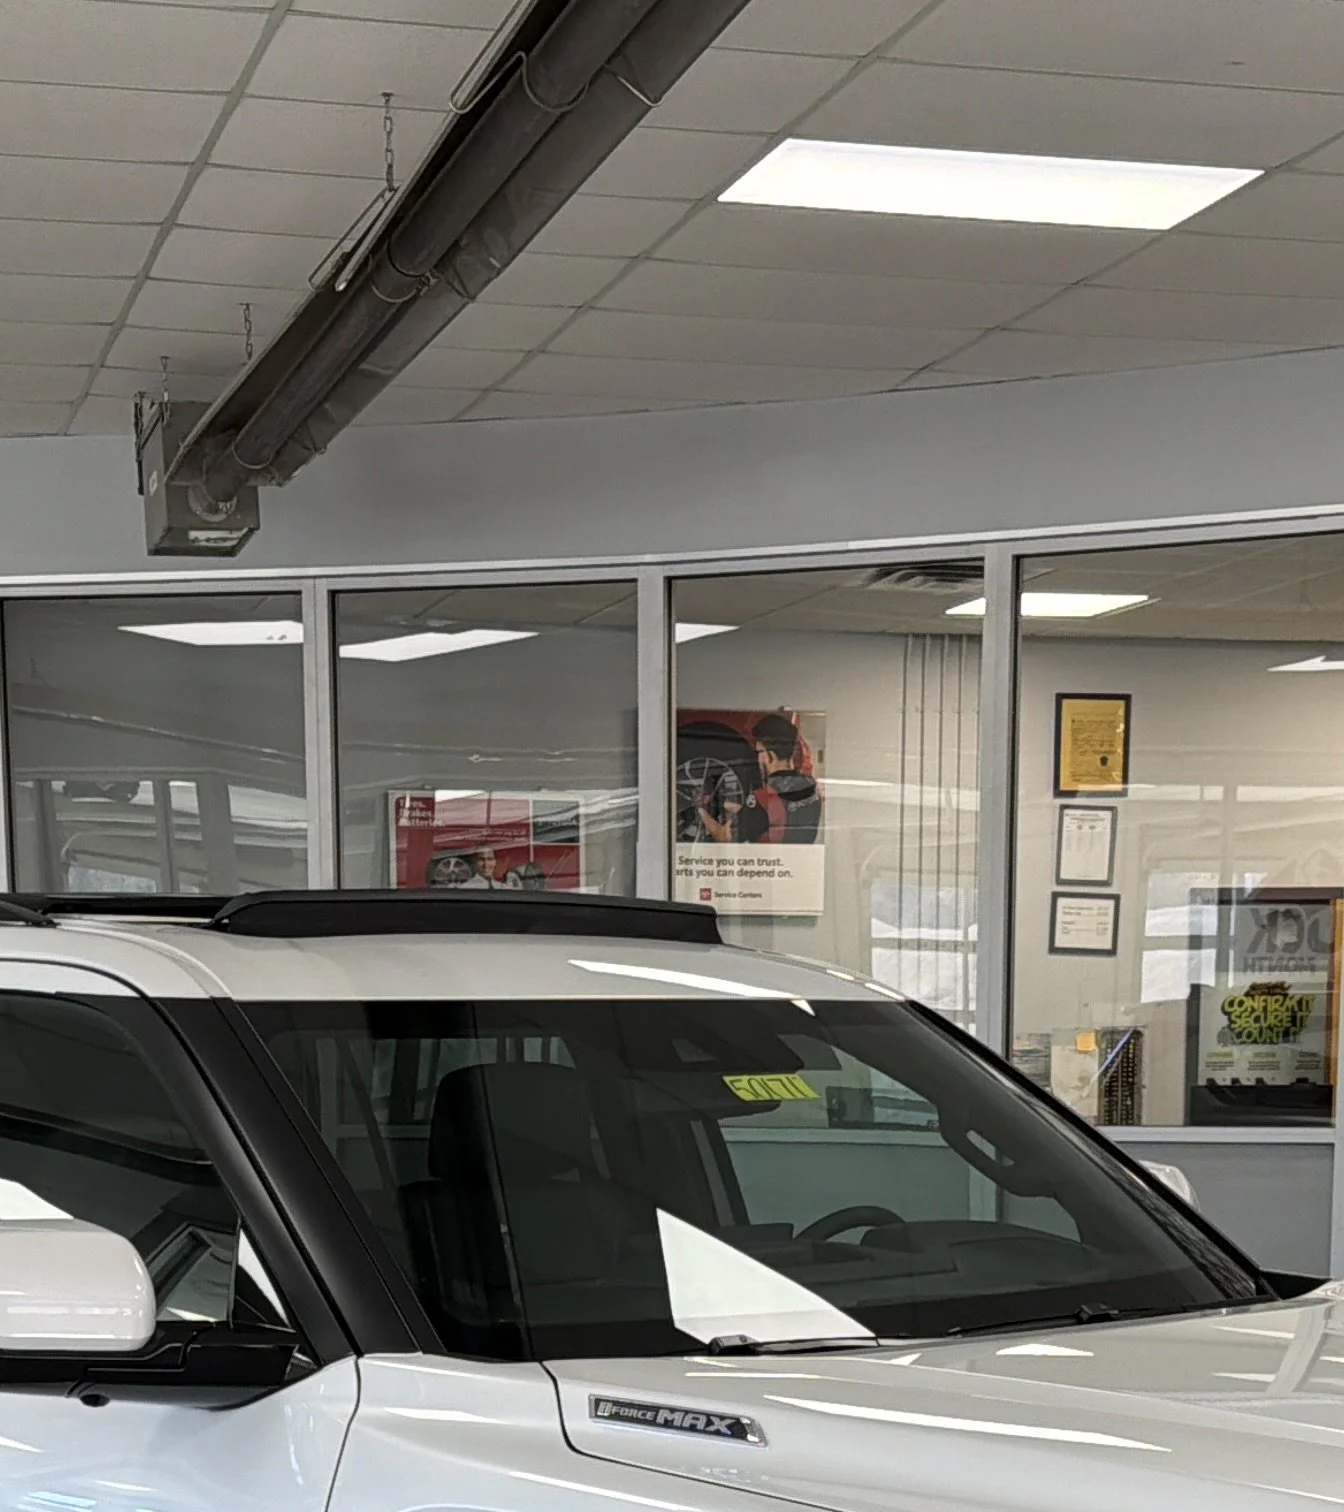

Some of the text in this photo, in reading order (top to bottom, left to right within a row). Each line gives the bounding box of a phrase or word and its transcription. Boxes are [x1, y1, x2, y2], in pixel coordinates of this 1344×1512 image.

[678, 856, 784, 868] Service you can trust.
[675, 868, 794, 879] arts you can depend on.
[1224, 995, 1299, 1013] CONFIRM
[1231, 1011, 1292, 1029] SECURE
[1234, 1026, 1283, 1043] COUNT
[656, 1408, 736, 1435] MAX
